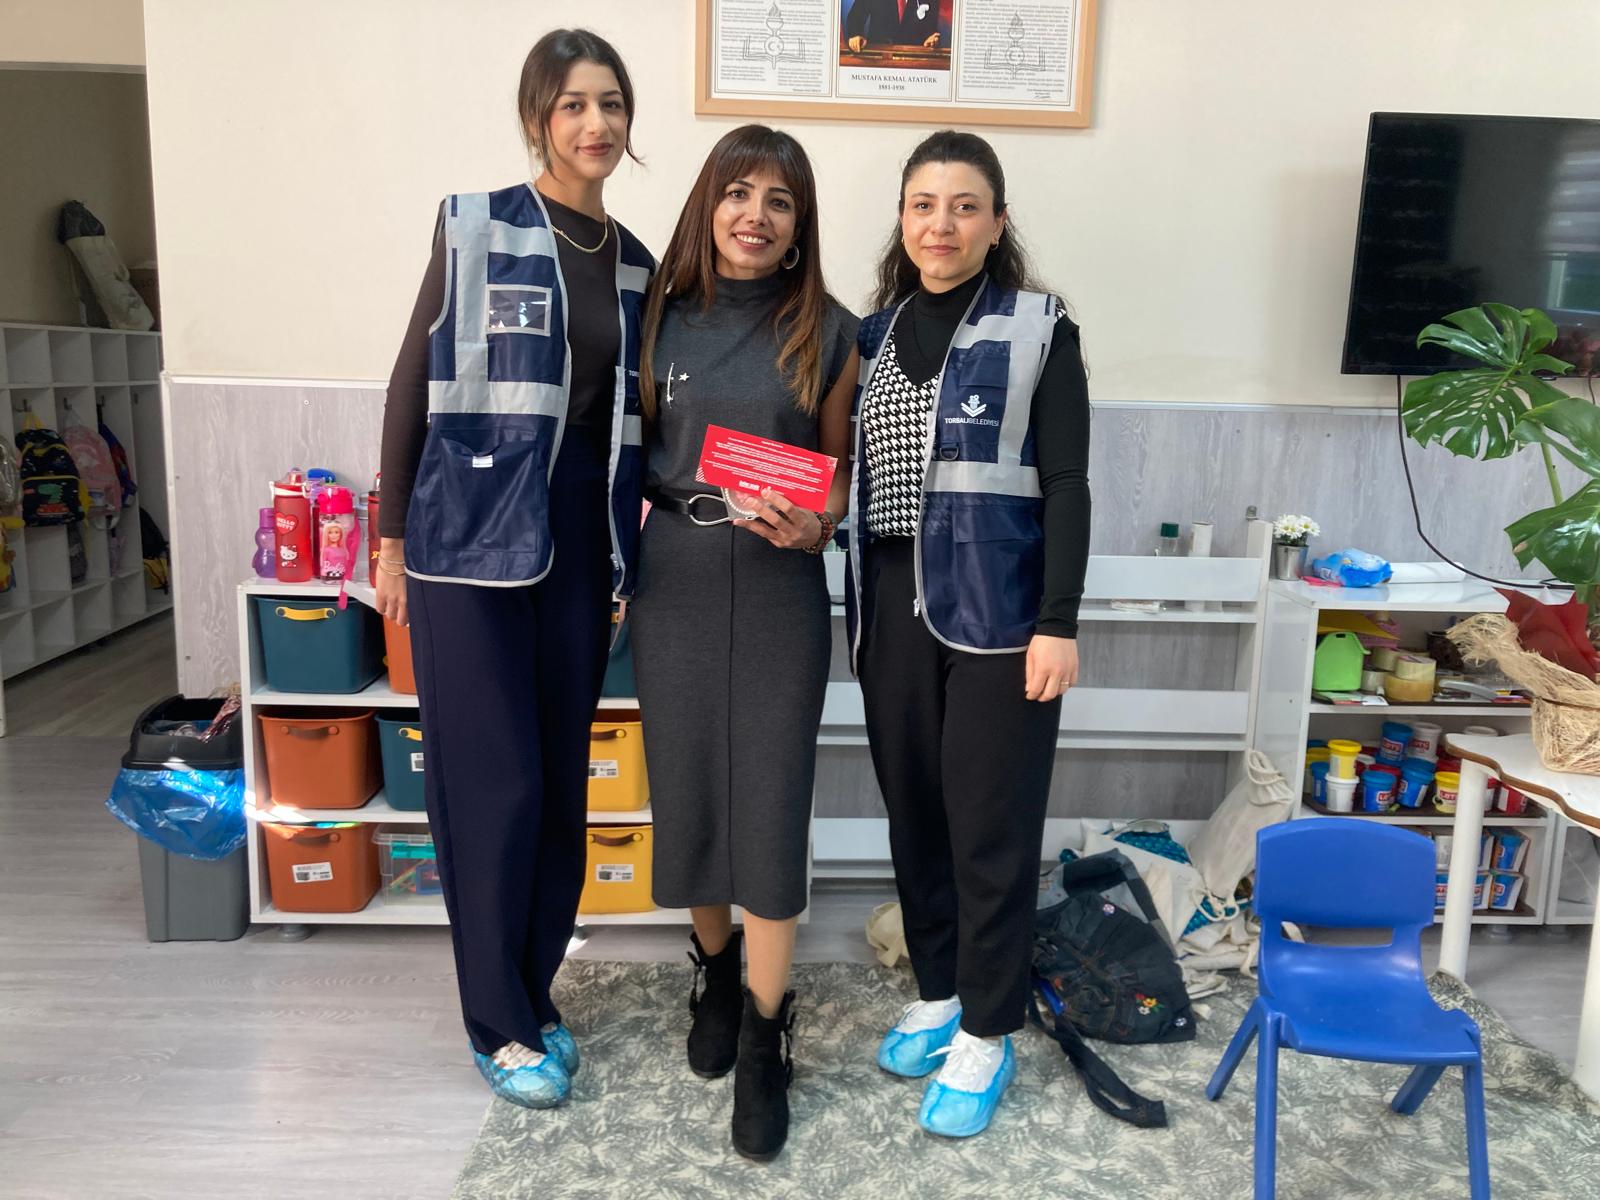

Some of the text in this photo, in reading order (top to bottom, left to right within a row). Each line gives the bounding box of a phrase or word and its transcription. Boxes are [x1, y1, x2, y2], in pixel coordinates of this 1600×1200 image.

[851, 73, 937, 83] MUSTAFA KEMAL ATATÜRK
